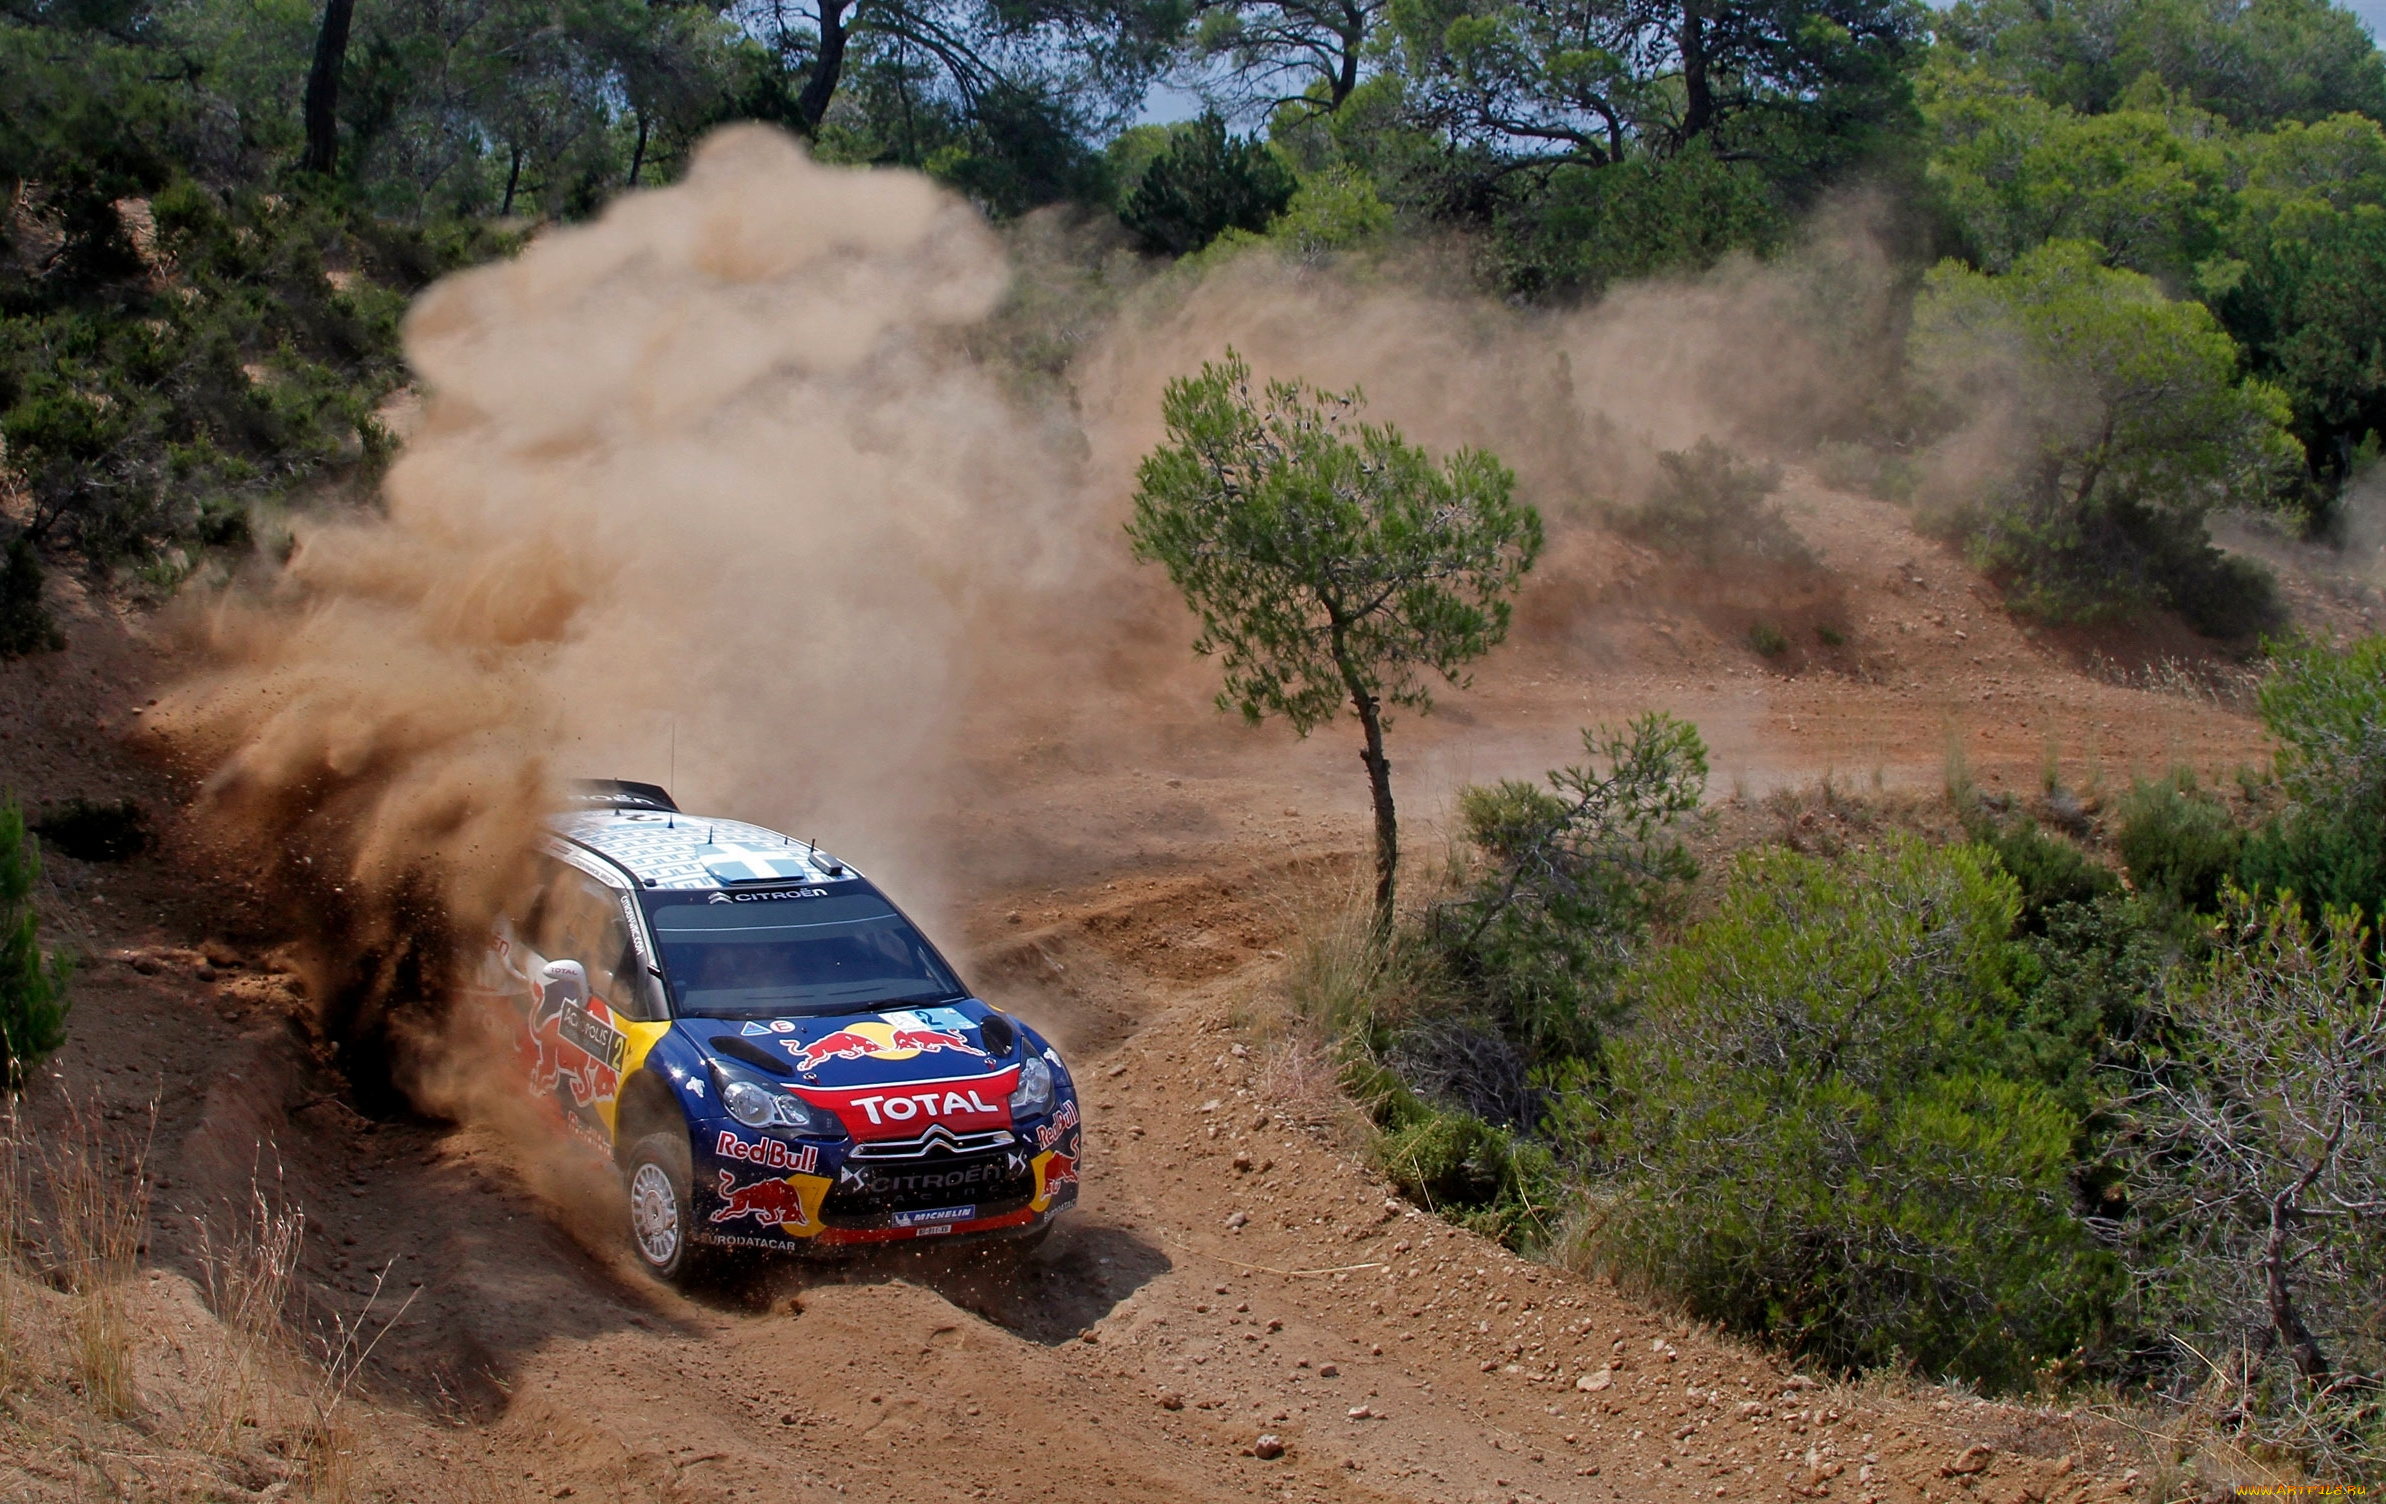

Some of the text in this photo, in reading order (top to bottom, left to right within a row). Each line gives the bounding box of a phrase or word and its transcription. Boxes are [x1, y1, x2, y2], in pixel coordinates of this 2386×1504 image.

[551, 967, 578, 976] TOTAL
[914, 1010, 944, 1026] 2
[564, 1007, 608, 1046] ACPOLIS
[612, 1036, 624, 1071] 2
[850, 1090, 999, 1125] TOTAL
[913, 1207, 972, 1222] MICHELIN
[703, 1235, 796, 1251] URODATACAR
